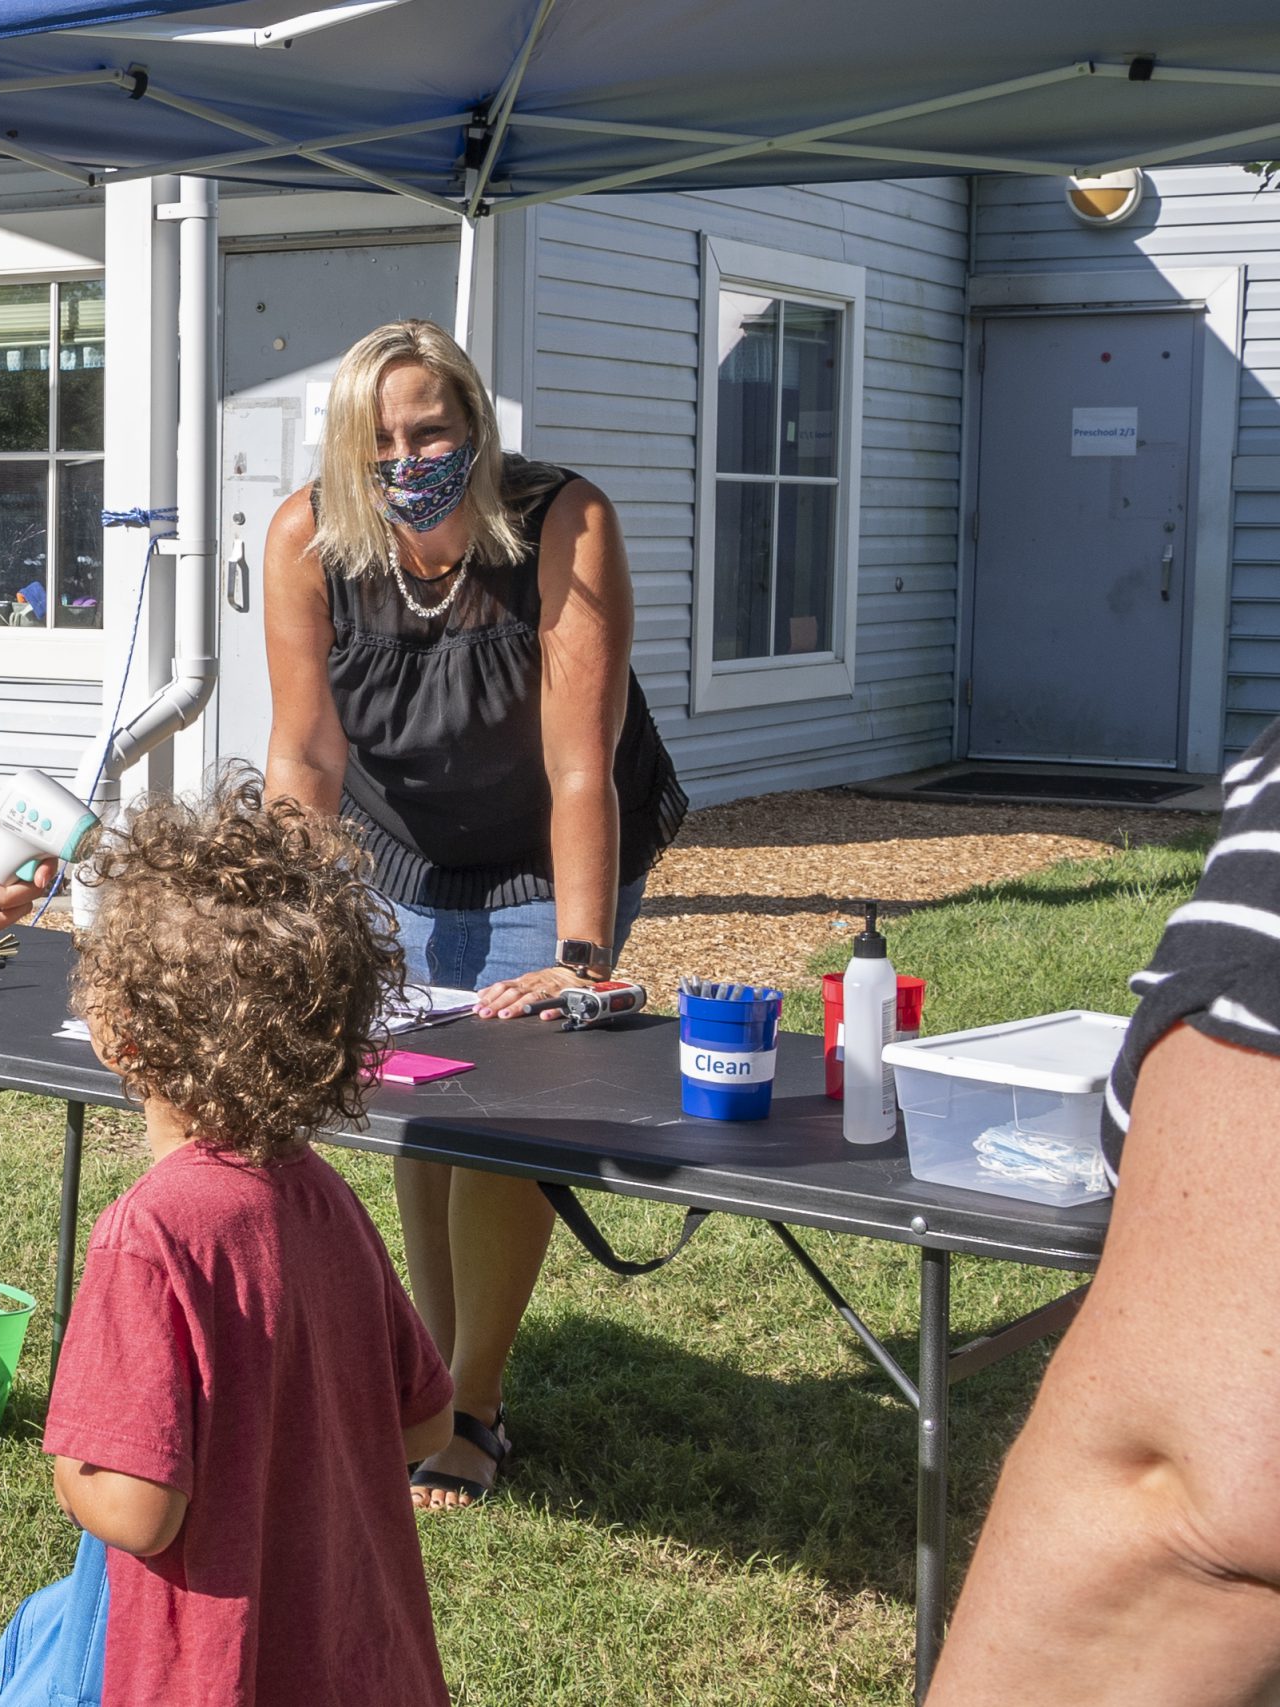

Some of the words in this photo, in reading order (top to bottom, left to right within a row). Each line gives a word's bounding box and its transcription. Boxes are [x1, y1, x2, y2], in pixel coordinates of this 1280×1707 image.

[1073, 428, 1118, 437] Preschool
[1119, 428, 1136, 438] 2/3
[695, 1054, 751, 1075] Clean
